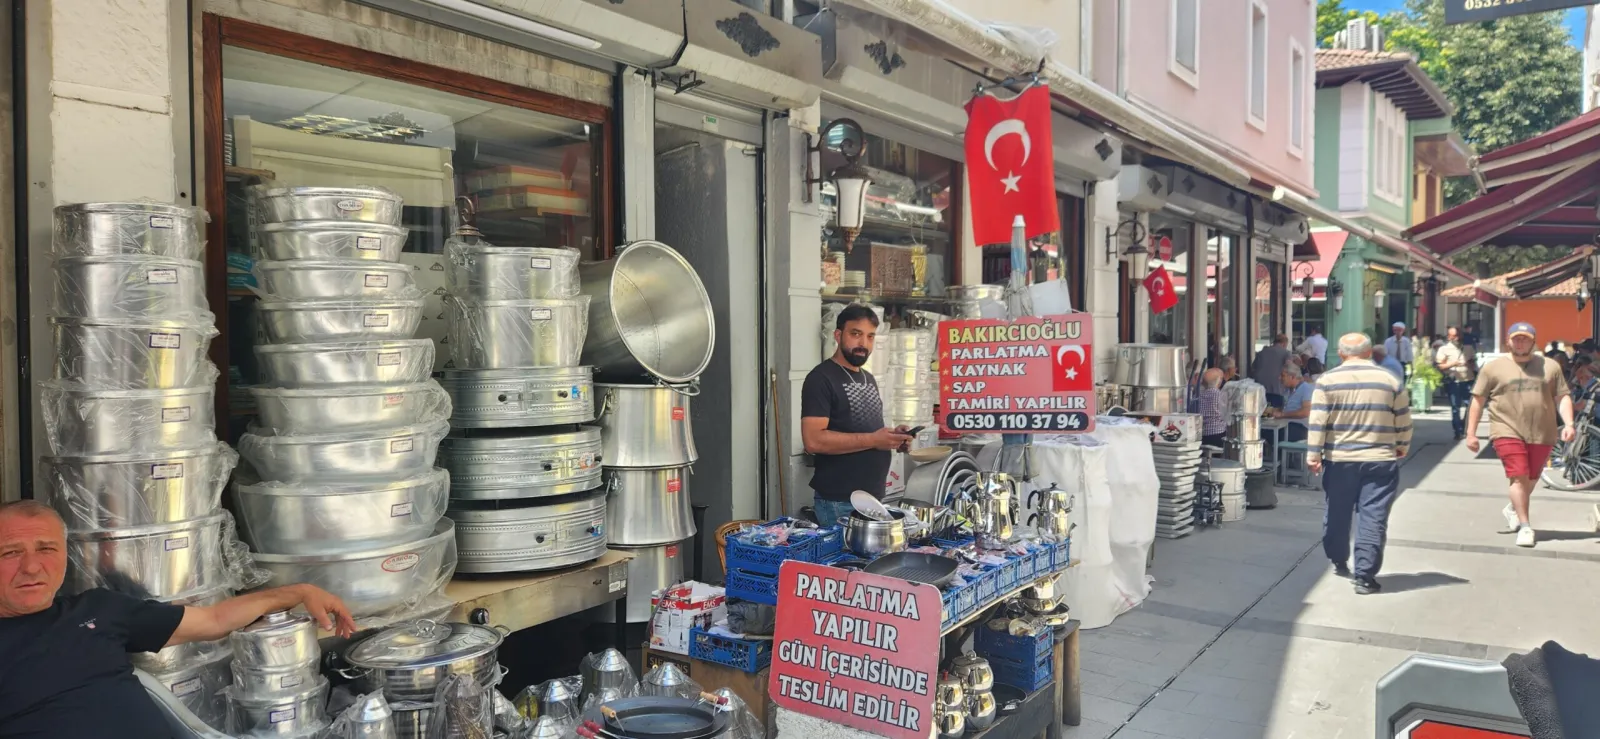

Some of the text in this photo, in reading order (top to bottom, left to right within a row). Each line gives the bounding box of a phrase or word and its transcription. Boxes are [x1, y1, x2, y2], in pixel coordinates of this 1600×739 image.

[948, 319, 1082, 344] BAKIRCIOĞLU
[951, 344, 1048, 360] PARLATMA
[952, 362, 1026, 377] KAYNAK
[952, 381, 986, 394] SAP
[948, 395, 1087, 410] TAMİRİ YAPILIR
[953, 413, 1081, 429] 0530 110 37 94
[796, 573, 920, 621] PARLATMA
[811, 609, 899, 652] YAPILIR
[778, 639, 929, 696] GÜN İÇERİSİNDE
[778, 674, 920, 731] TESLİM EDİLİR
